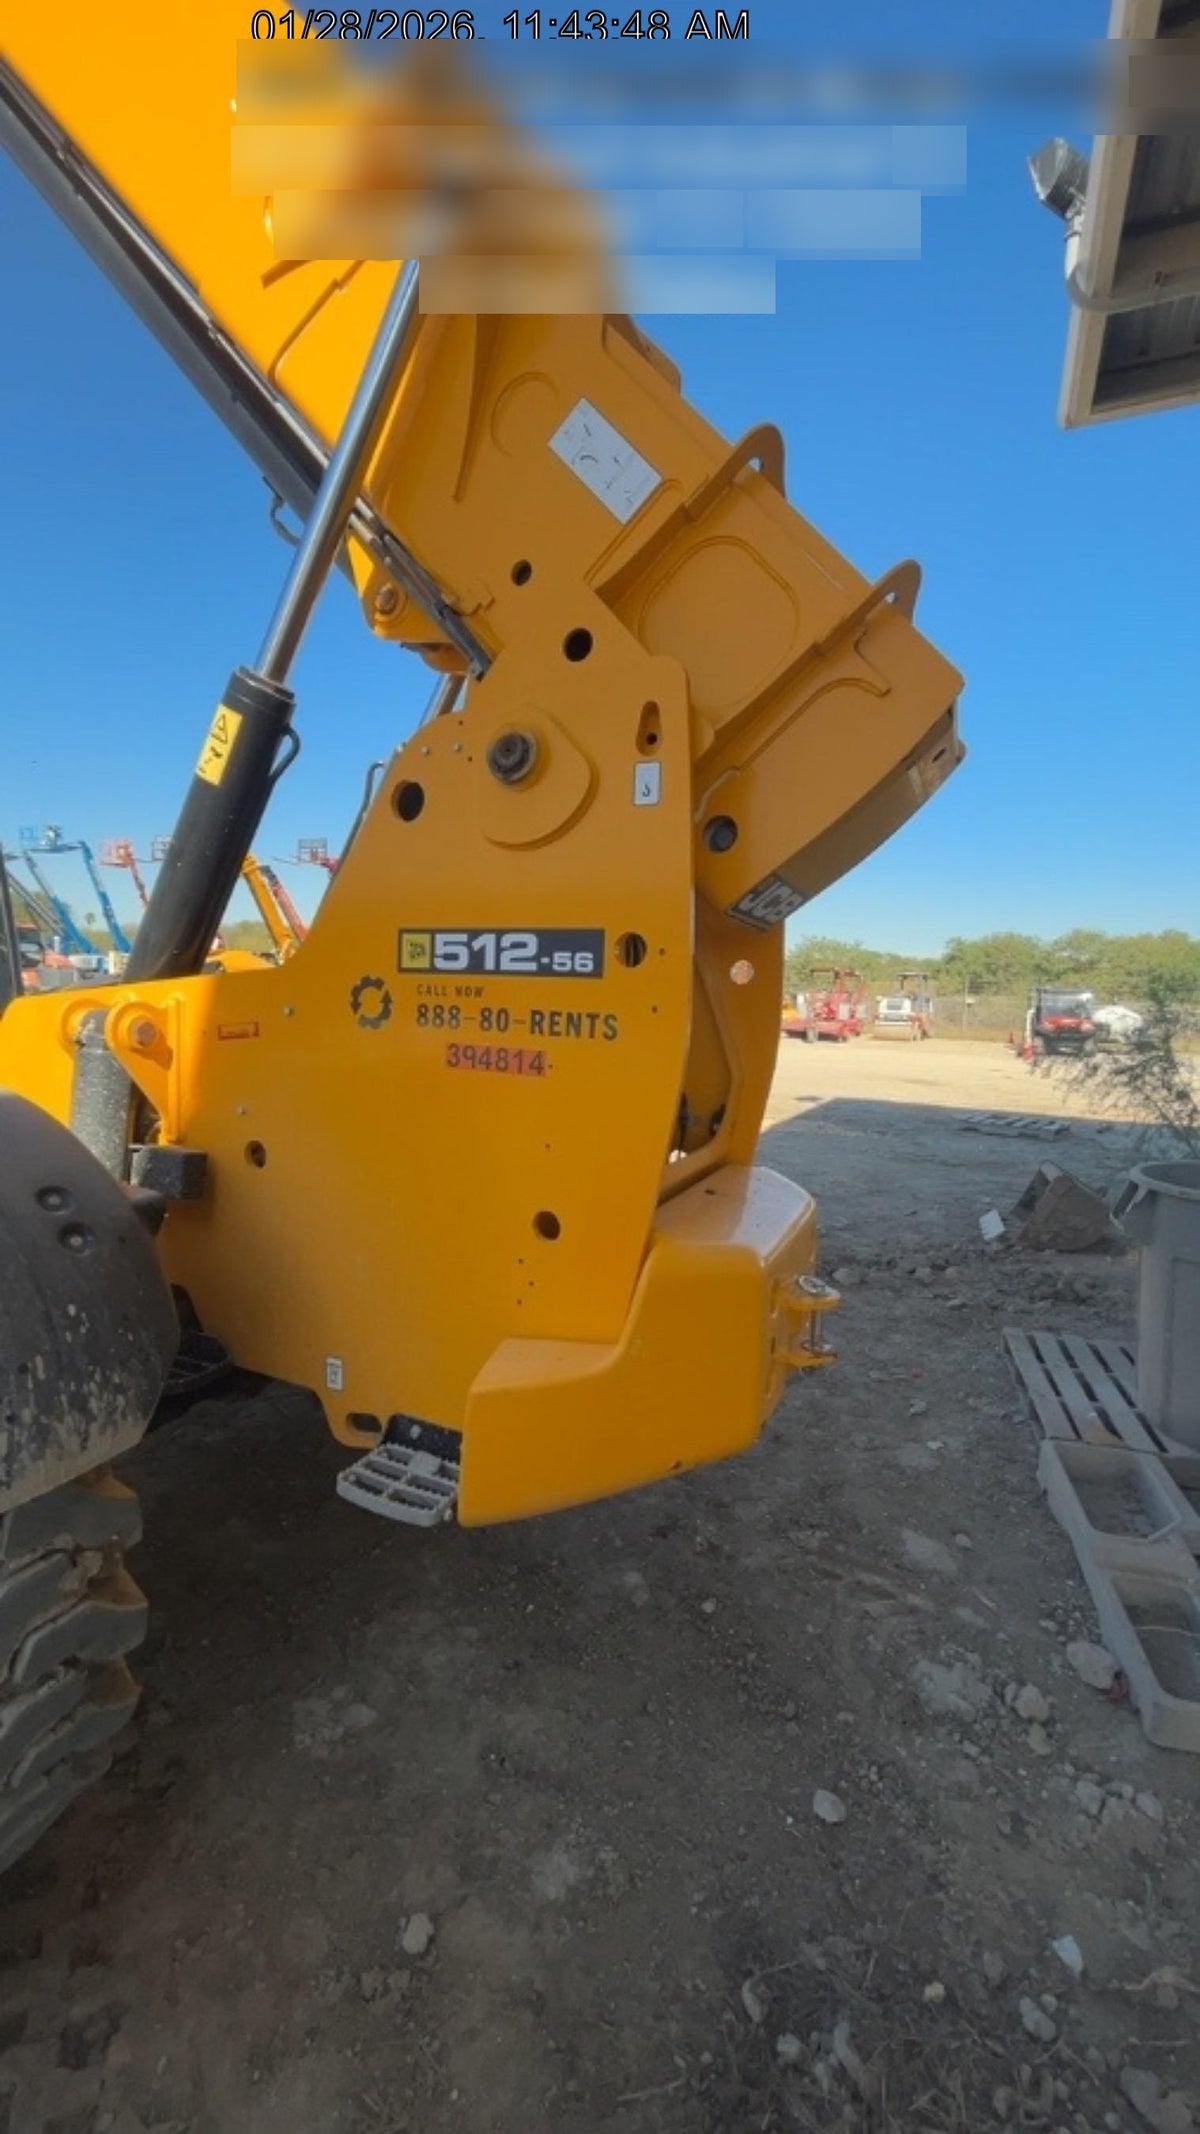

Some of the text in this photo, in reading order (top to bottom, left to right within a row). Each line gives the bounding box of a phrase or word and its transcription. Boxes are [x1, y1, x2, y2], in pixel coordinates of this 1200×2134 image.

[432, 932, 595, 973] 512-56
[416, 983, 484, 998] CALL NOW
[416, 1003, 618, 1041] 888-80-RENTS
[446, 1042, 545, 1075] 394814
